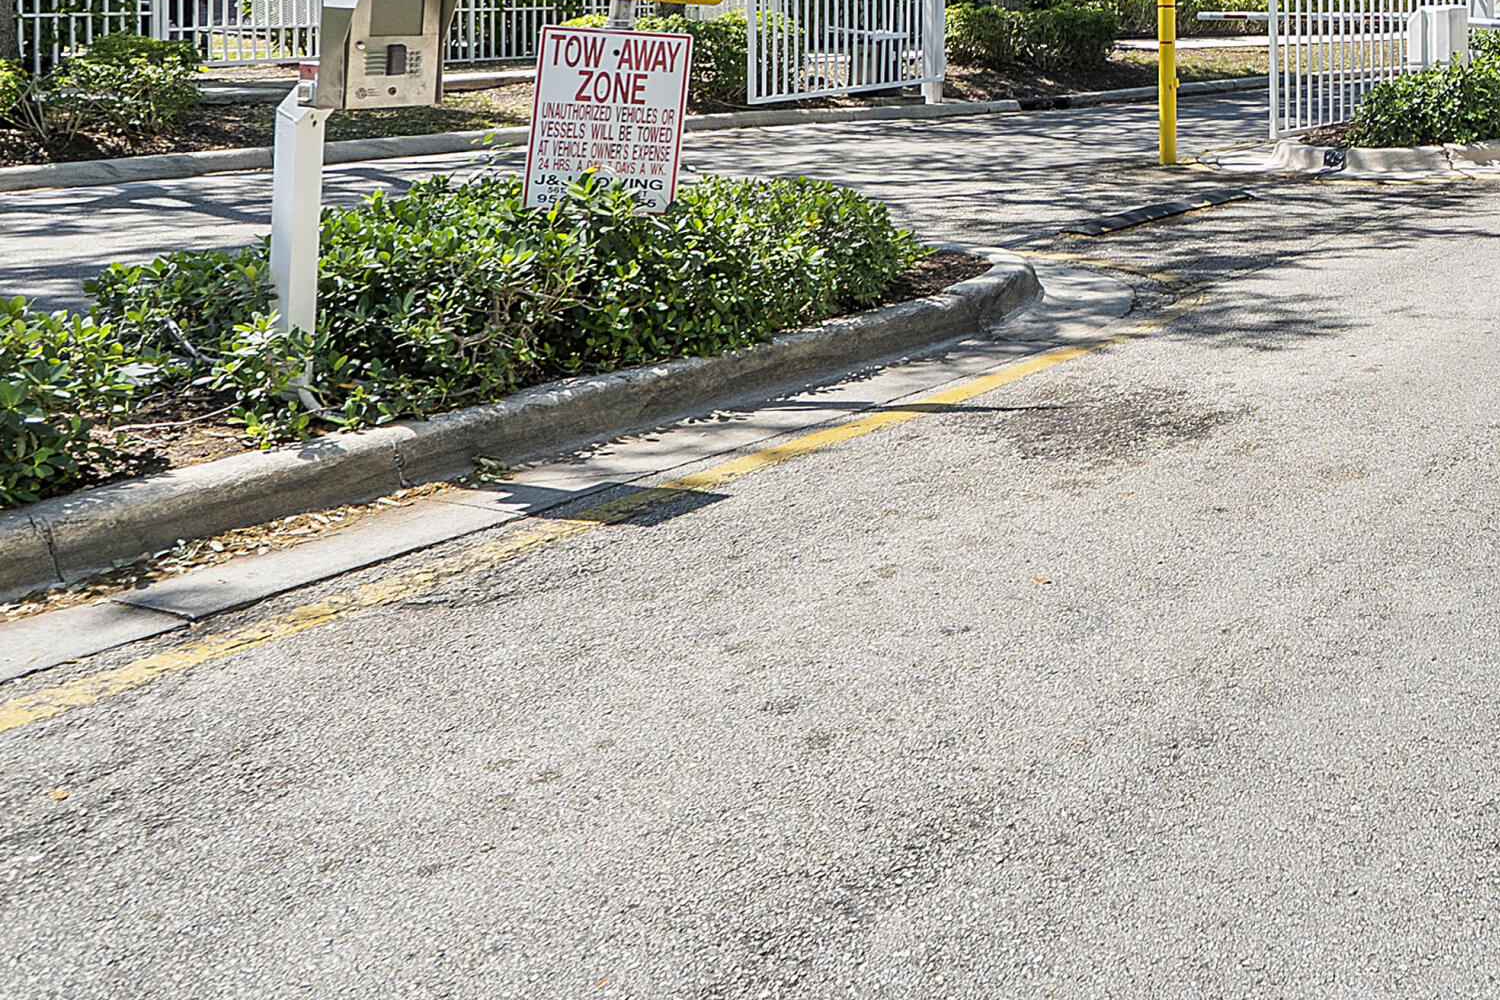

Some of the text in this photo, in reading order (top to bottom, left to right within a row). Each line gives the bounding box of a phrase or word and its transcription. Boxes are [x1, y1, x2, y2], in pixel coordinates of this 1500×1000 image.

[550, 34, 682, 73] TOW AWAY
[575, 70, 648, 105] ZONE
[542, 102, 675, 125] UNAUTHORIZED VEHICLES OR
[540, 120, 673, 143] VESSELS WILL BE TOWED
[537, 140, 671, 162] AT VEHICLE OWNER'S EXPENSE
[538, 158, 549, 170] 24
[553, 159, 572, 172] HRS.
[577, 160, 583, 171] A
[615, 161, 636, 174] DAYS
[640, 163, 645, 174] A
[650, 163, 667, 176] WK.
